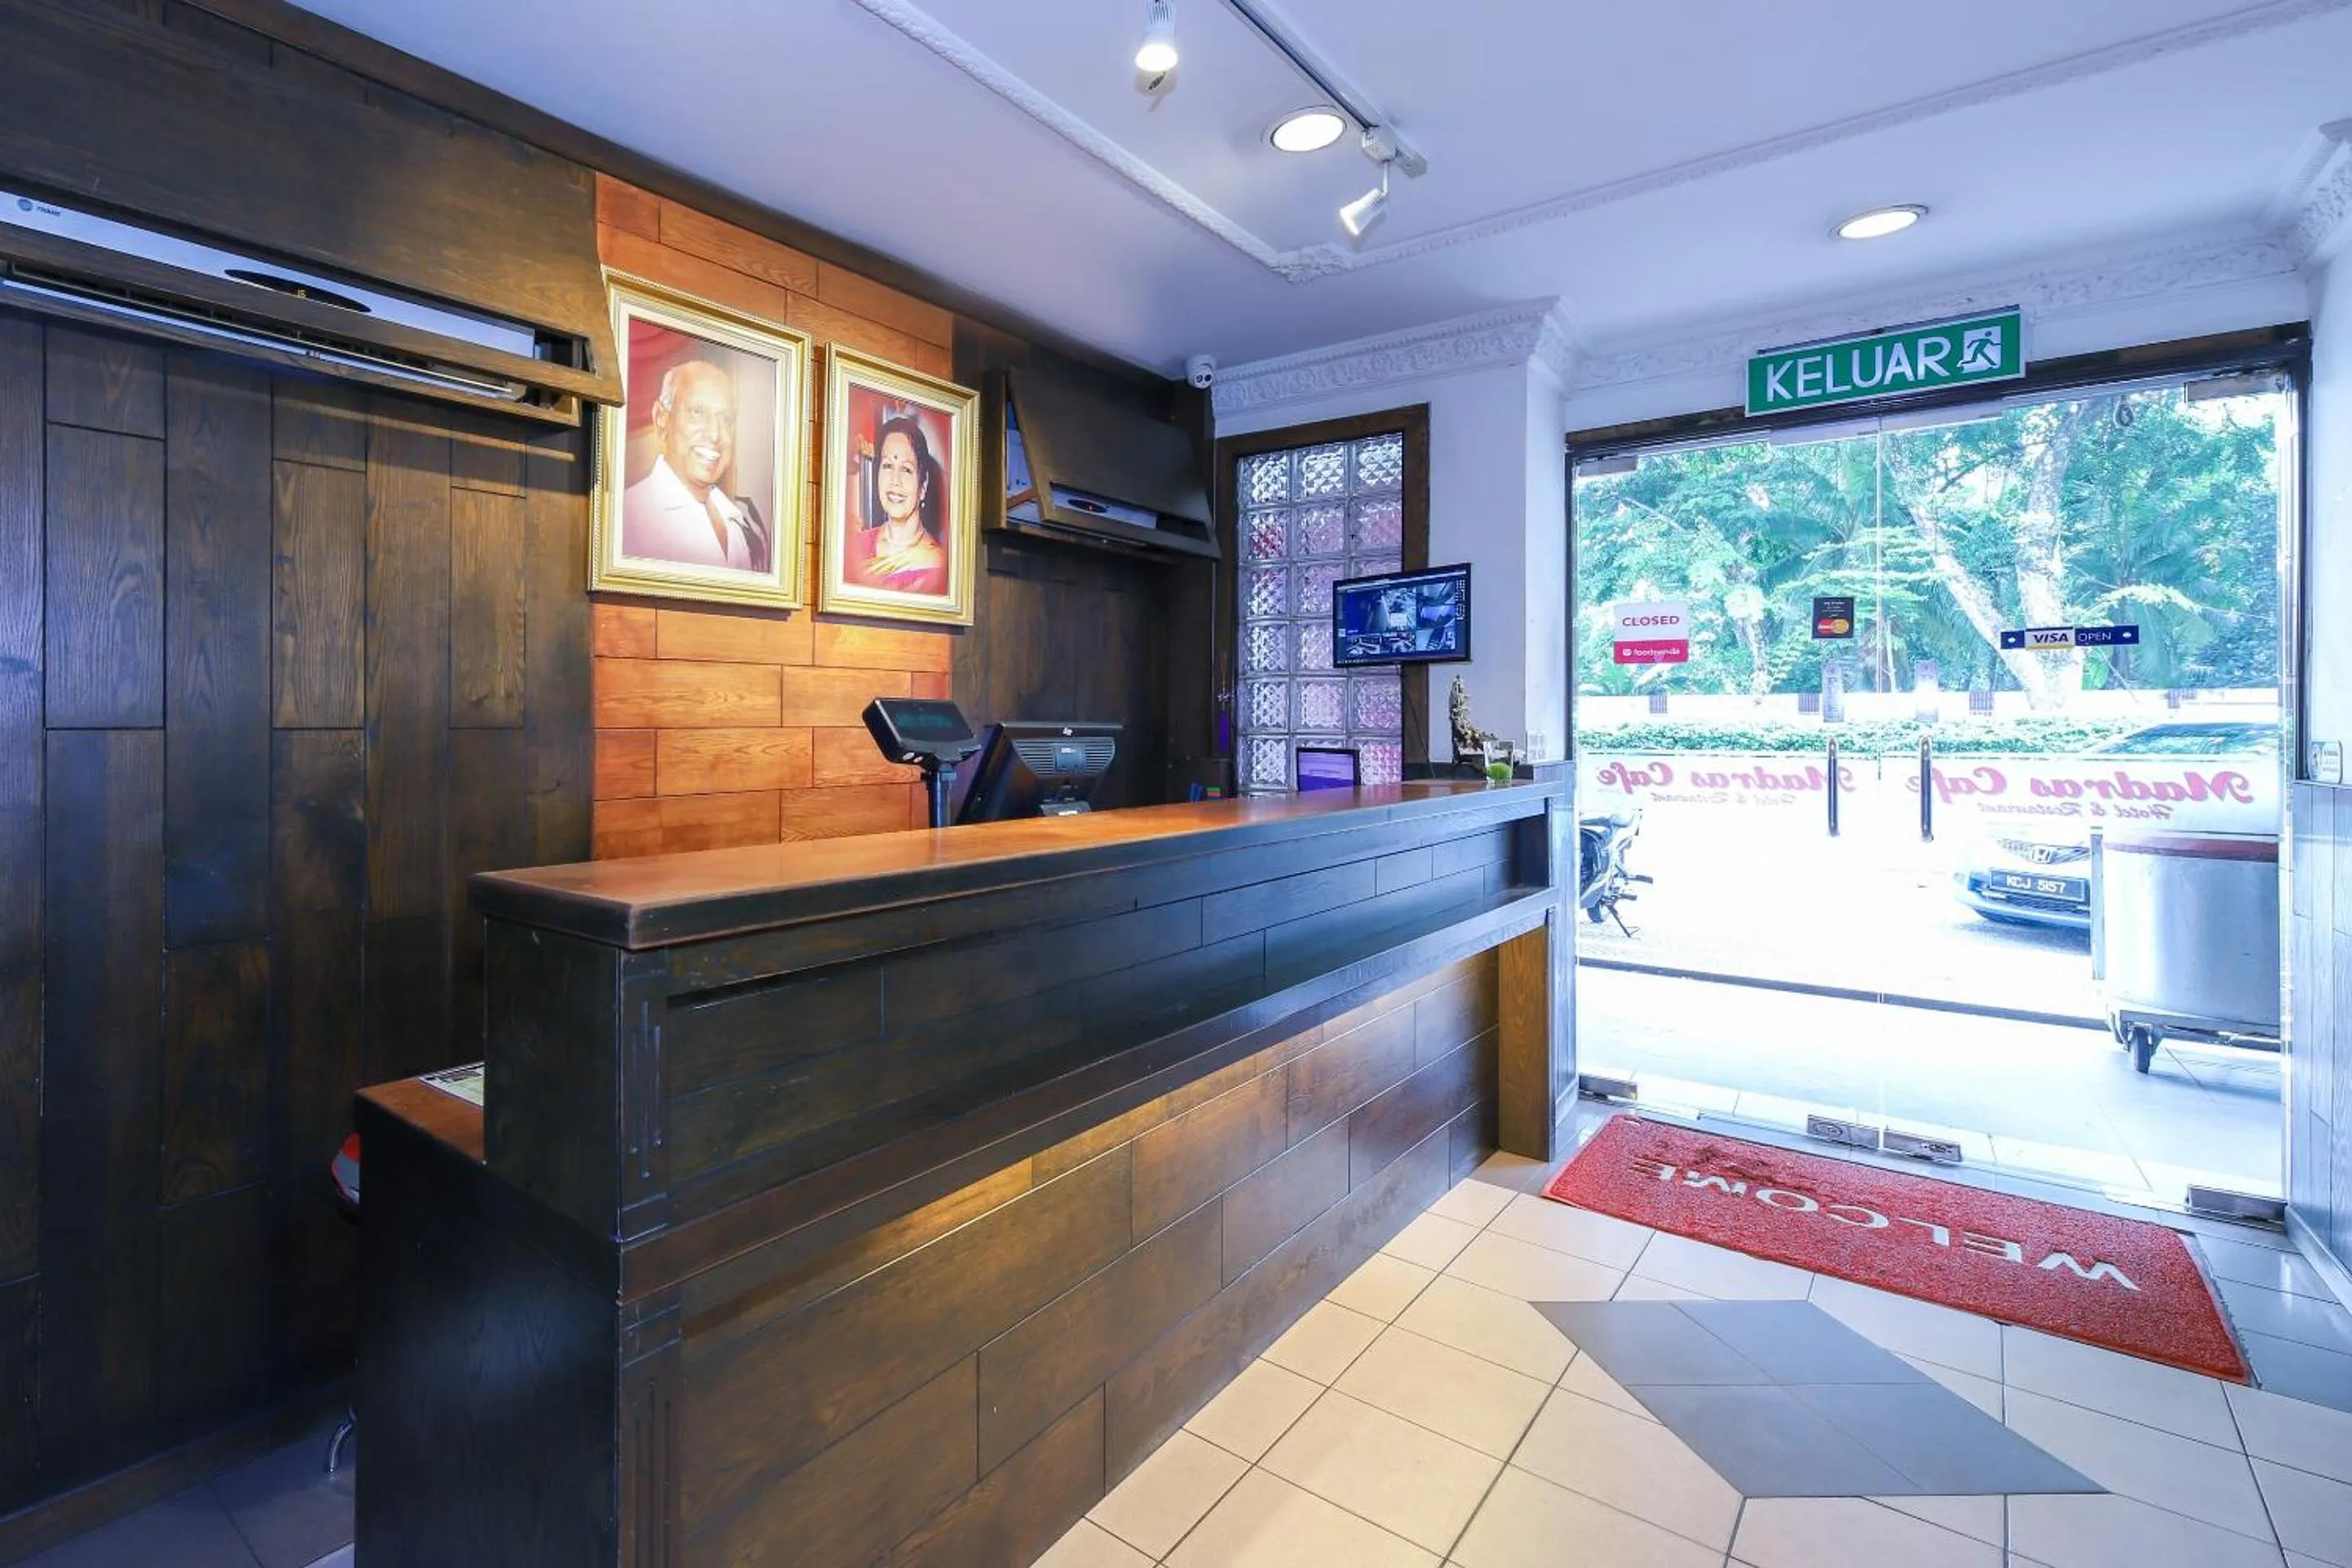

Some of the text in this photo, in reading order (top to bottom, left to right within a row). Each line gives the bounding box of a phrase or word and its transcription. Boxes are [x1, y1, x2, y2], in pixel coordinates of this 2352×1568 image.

[1766, 336, 1951, 403] KELUAR
[1622, 615, 1680, 627] CLOSED
[2034, 631, 2112, 644] VISA OPEN
[1628, 1156, 2140, 1291] WELCOME
